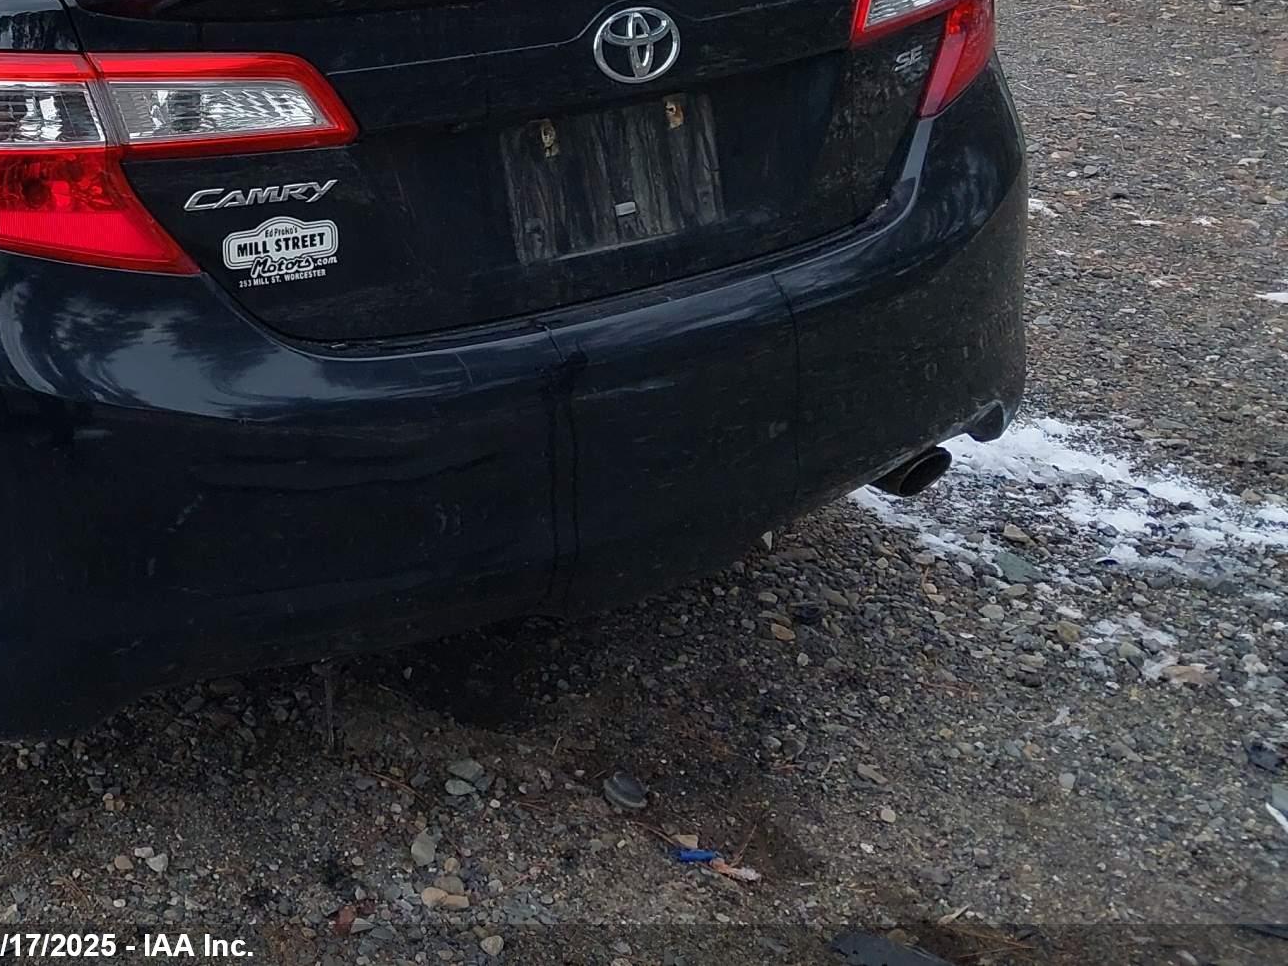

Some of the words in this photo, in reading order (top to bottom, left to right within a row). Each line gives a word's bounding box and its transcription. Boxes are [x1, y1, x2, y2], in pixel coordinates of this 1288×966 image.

[894, 44, 923, 72] SE
[183, 179, 338, 212] CAMRY
[237, 239, 270, 257] MILL
[274, 232, 325, 252] STREET
[264, 228, 273, 238] Ed
[253, 276, 269, 286] MILL
[271, 274, 282, 284] ST.
[284, 269, 326, 281] WORCESTER
